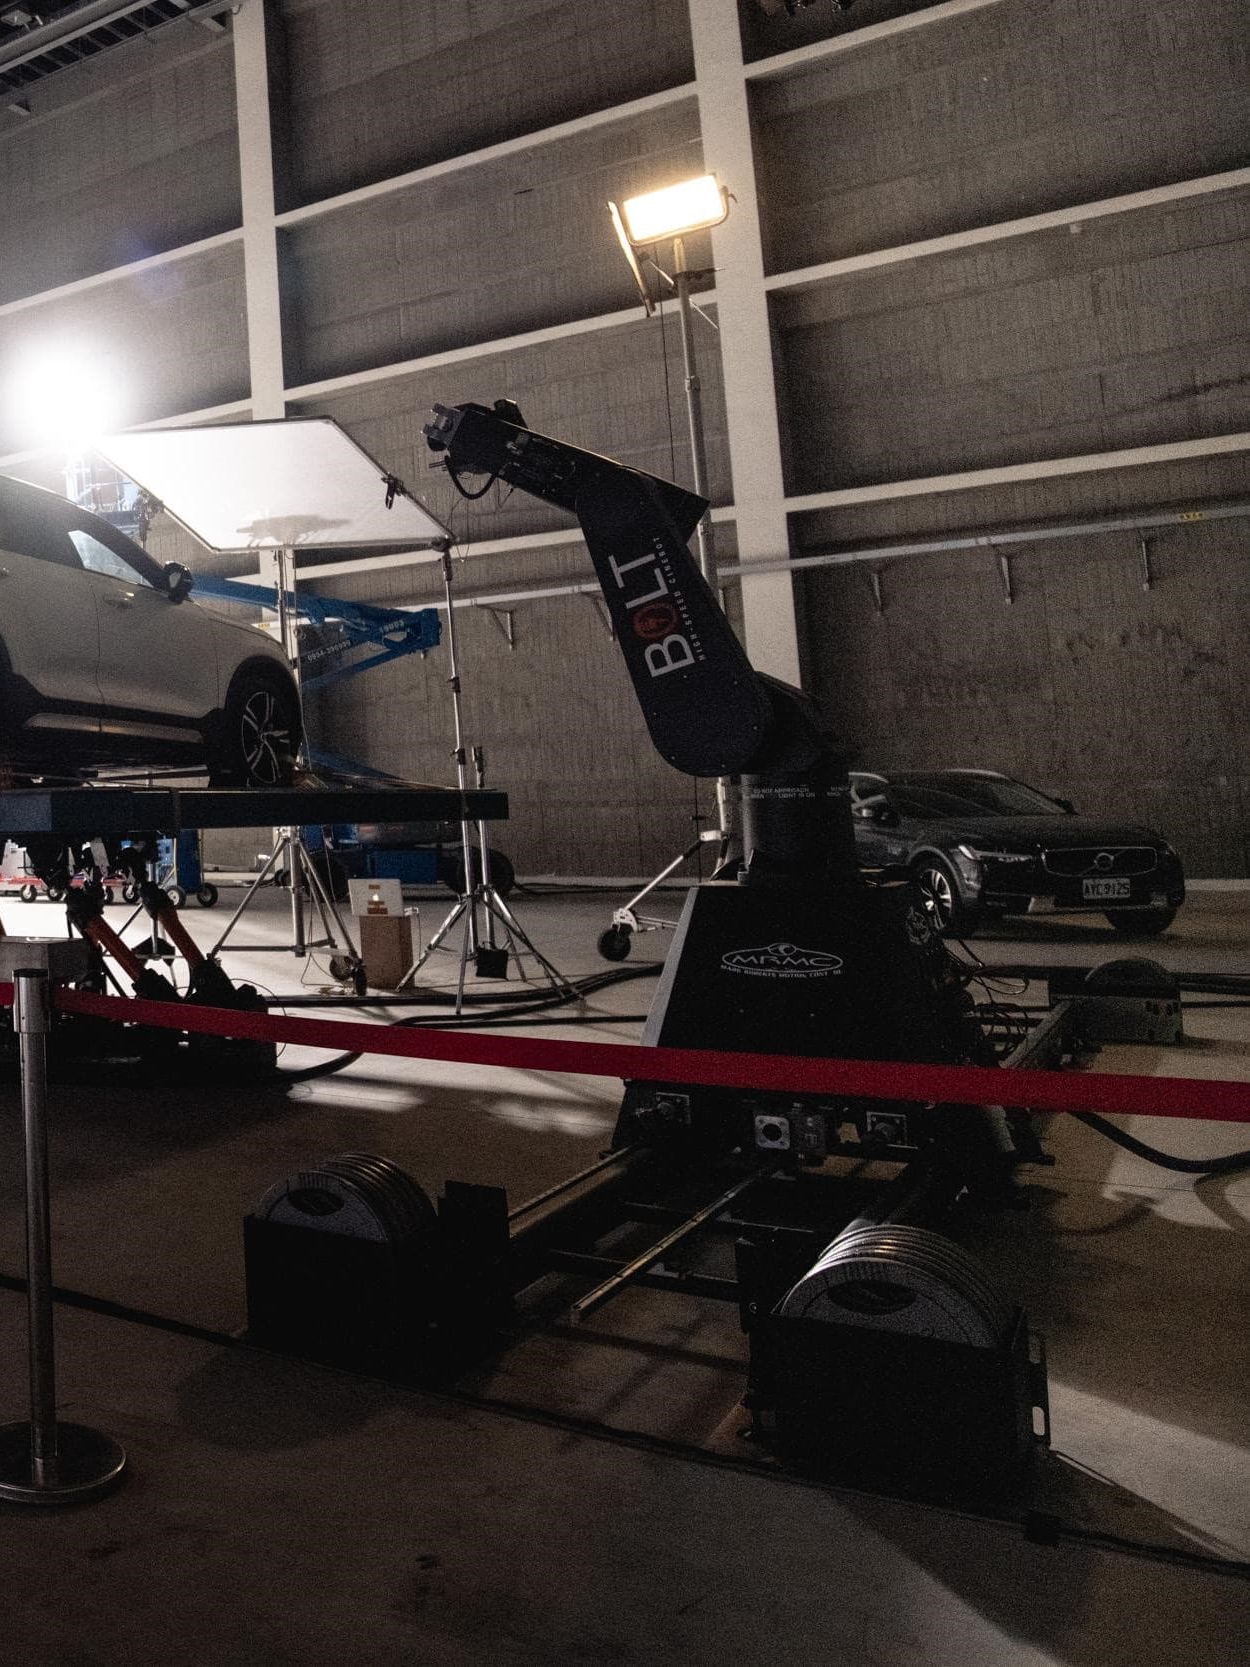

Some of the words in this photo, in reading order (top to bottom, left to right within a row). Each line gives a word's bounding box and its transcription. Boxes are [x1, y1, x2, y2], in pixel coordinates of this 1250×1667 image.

[608, 553, 695, 677] BOLT
[673, 590, 707, 661] HIGH-SPEED
[732, 955, 832, 966] MRMC
